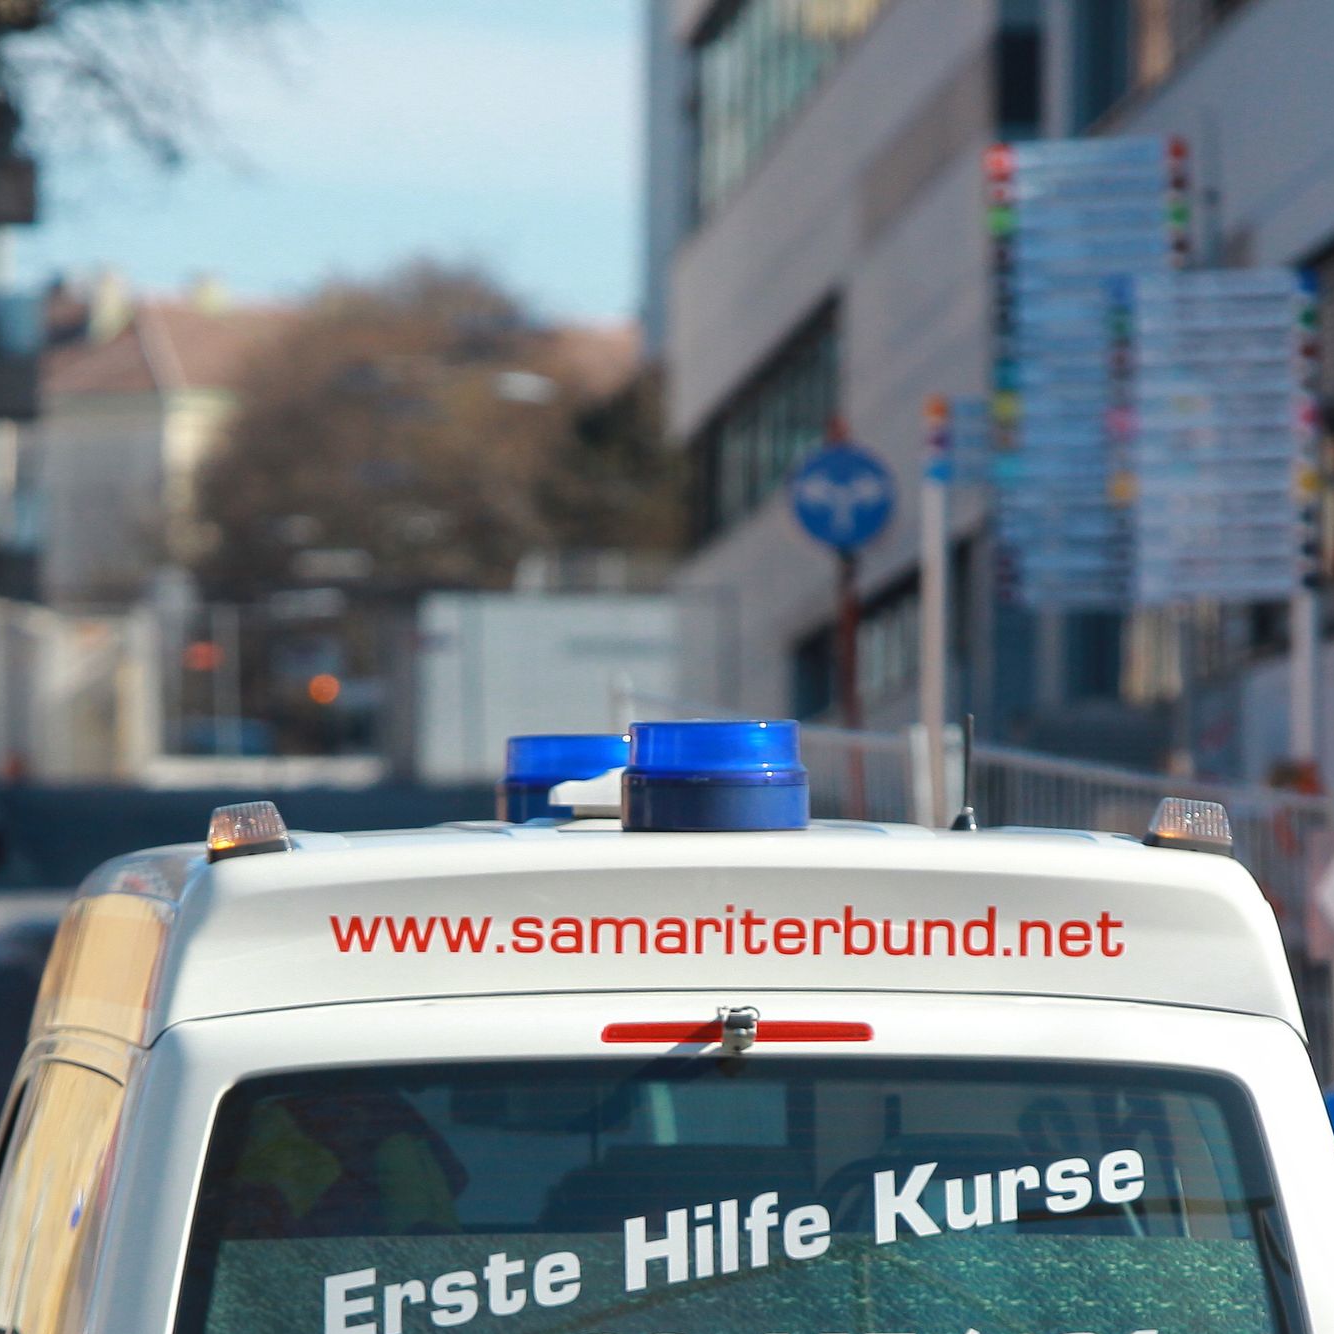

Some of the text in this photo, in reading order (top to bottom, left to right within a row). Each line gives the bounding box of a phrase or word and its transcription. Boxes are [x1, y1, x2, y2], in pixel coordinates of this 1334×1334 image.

[329, 903, 1126, 959] www.samariterbund.net
[623, 1190, 832, 1293] Hilfe
[873, 1148, 1146, 1246] Kurse
